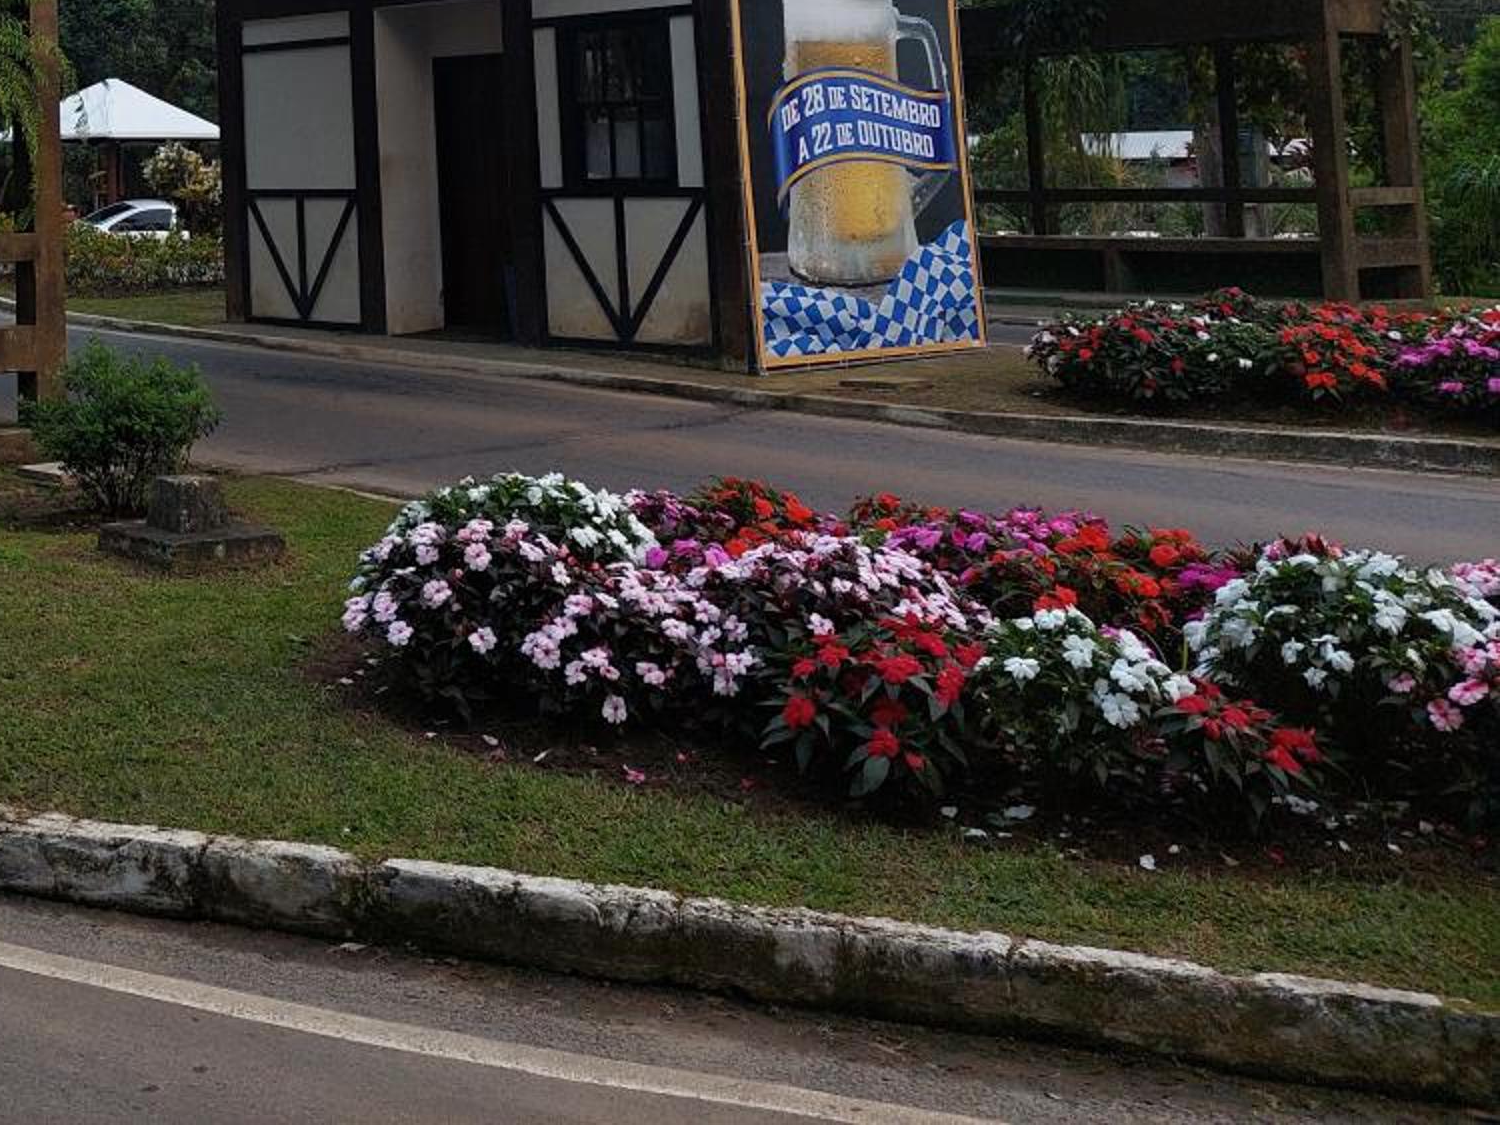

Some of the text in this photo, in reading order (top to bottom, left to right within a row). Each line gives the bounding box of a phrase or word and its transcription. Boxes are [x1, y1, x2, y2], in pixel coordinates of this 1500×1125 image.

[781, 83, 941, 132] DE 28 DE SETEMBRO
[798, 120, 936, 164] A 22 DE OUTUBRO
